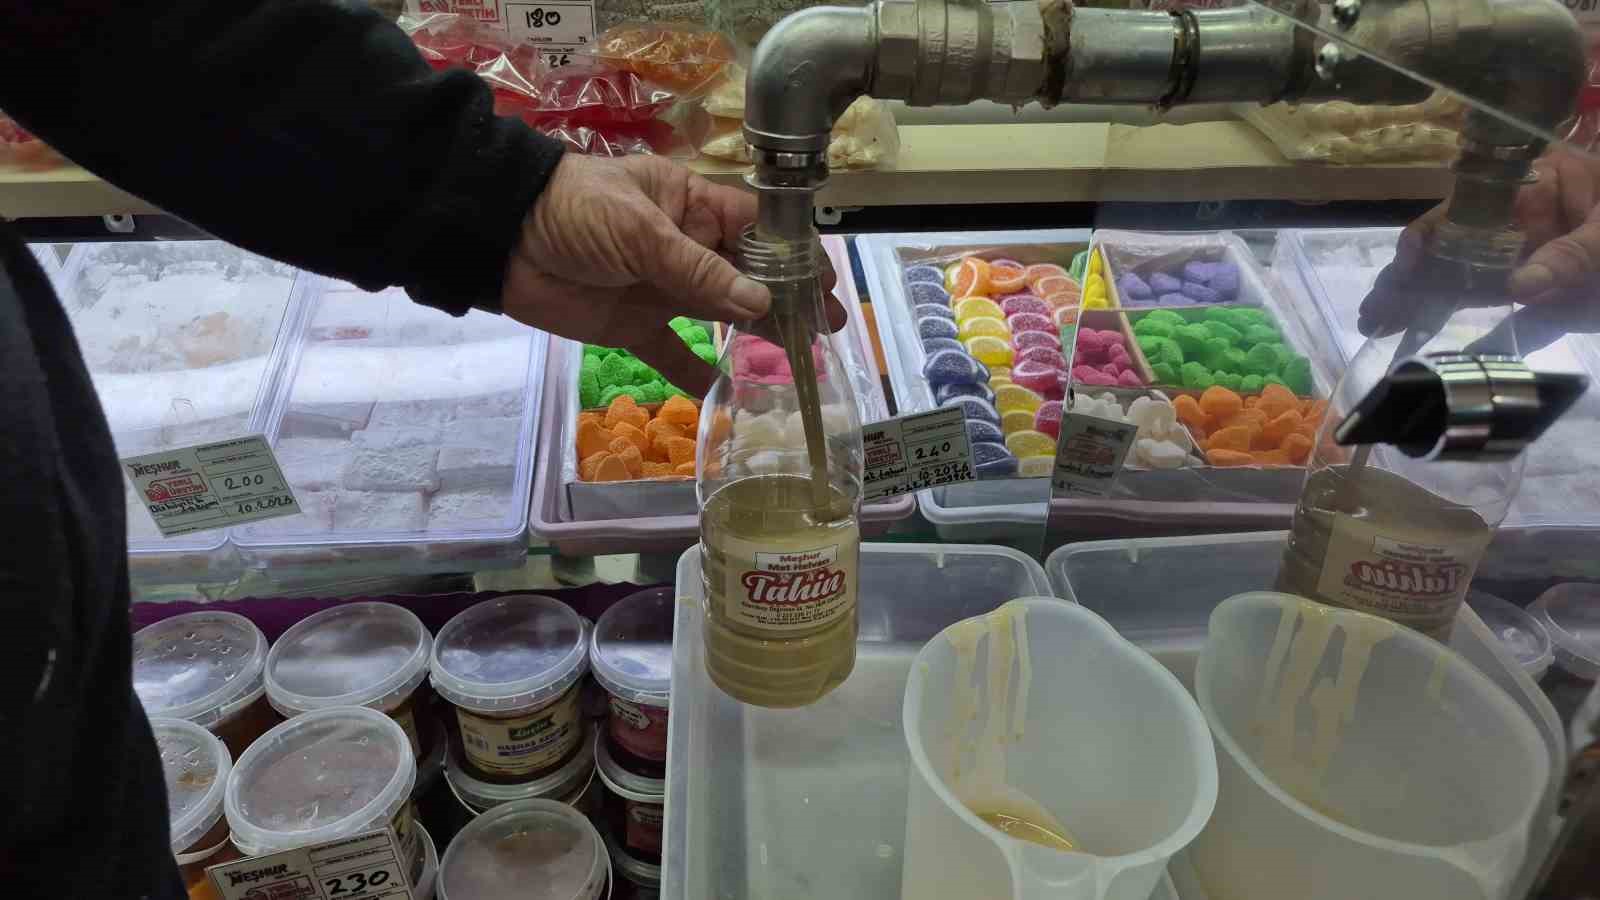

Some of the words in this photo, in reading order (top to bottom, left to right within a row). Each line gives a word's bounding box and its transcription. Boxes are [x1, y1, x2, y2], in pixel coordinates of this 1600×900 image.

[525, 8, 561, 28] 180
[915, 441, 951, 460] 240
[743, 568, 845, 604] Tahin
[326, 870, 390, 895] 230
